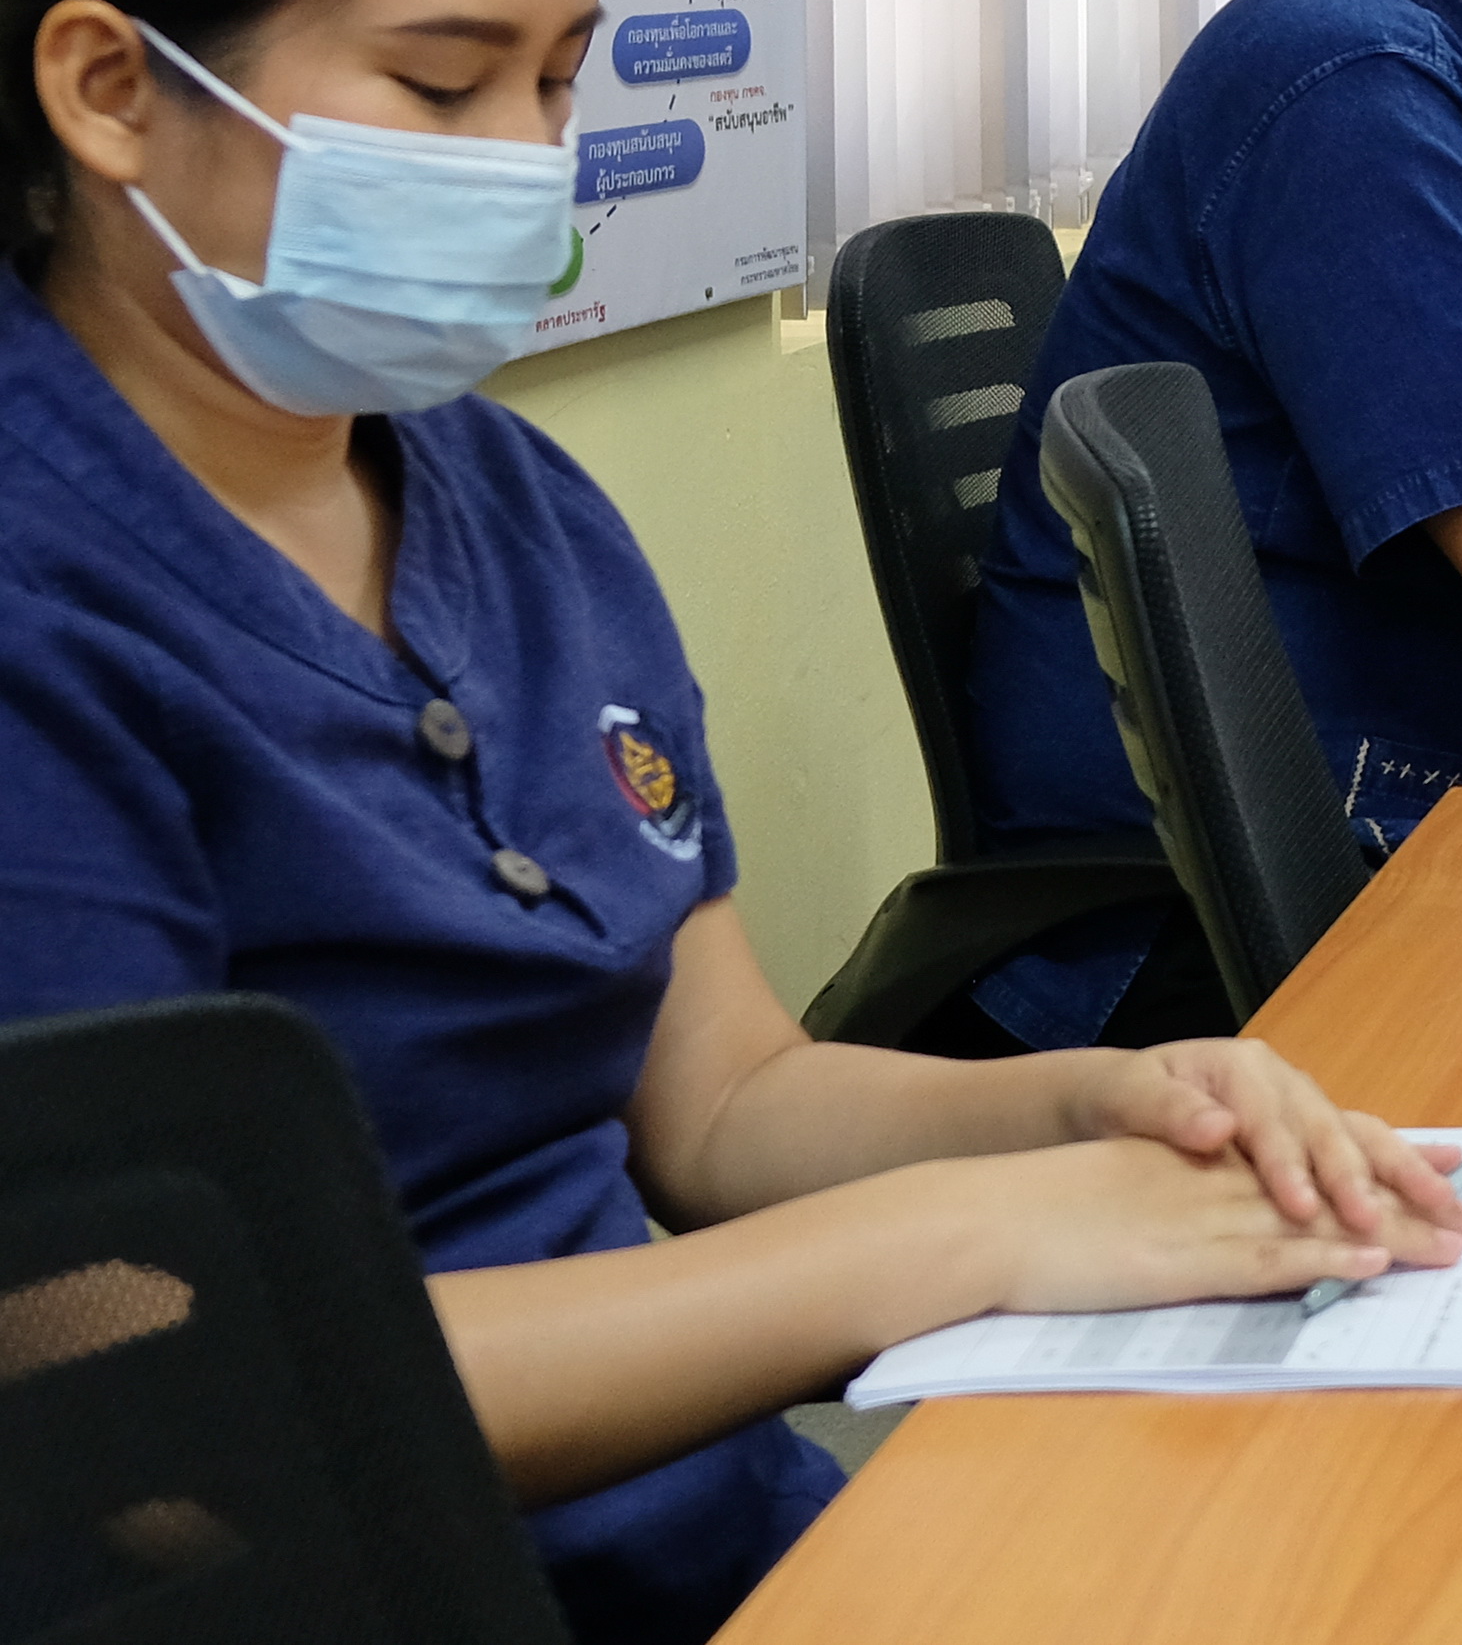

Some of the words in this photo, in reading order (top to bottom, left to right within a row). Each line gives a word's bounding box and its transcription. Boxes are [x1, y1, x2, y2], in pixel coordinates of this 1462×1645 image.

[628, 16, 737, 48] กองทุนเพื่อโอกาสและ
[634, 46, 732, 75] ความมั่นคงของสตรี
[710, 89, 739, 106] กองทุน
[588, 129, 682, 163] กองทุนสนับสนุน
[596, 165, 675, 198] ผู้ประกอบการ
